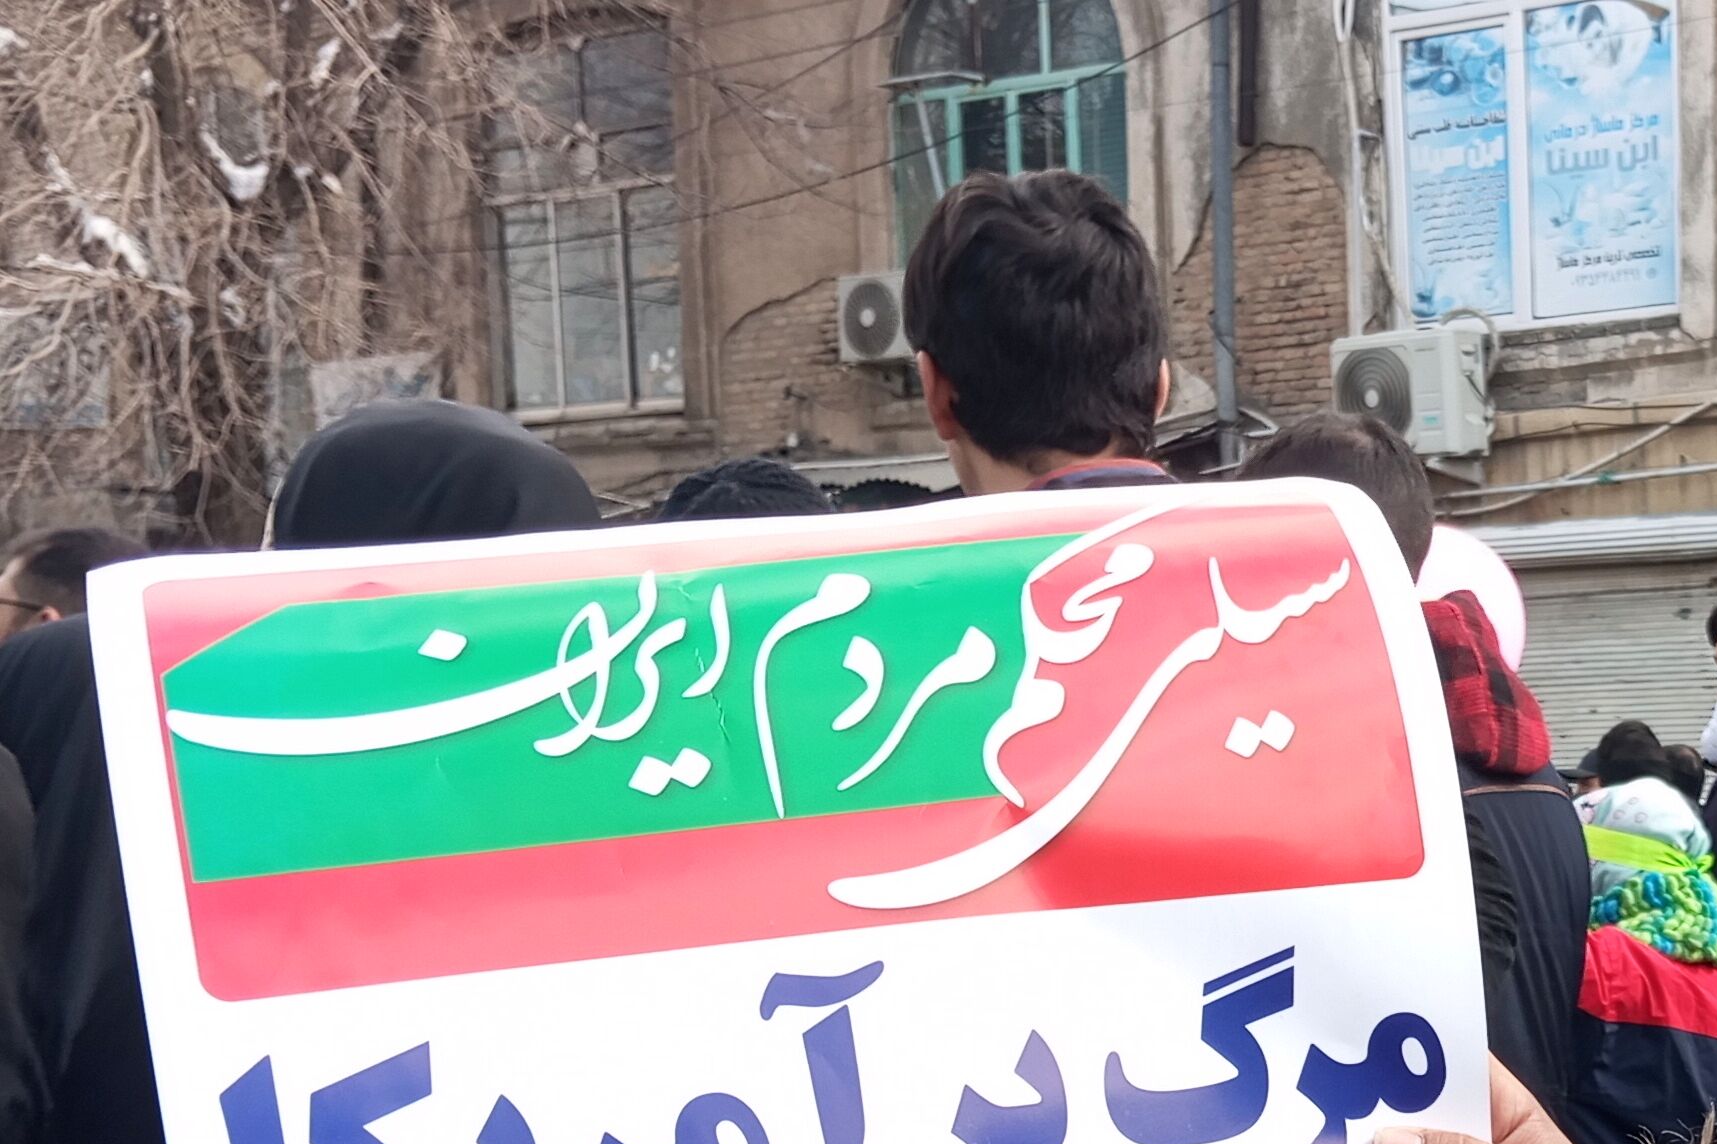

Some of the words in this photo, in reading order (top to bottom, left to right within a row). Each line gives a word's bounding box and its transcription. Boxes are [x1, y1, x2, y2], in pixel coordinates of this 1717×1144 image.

[1545, 147, 1608, 180] سینا
[1617, 134, 1658, 172] ابن
[166, 570, 712, 796] ایران
[753, 573, 996, 818] مردم
